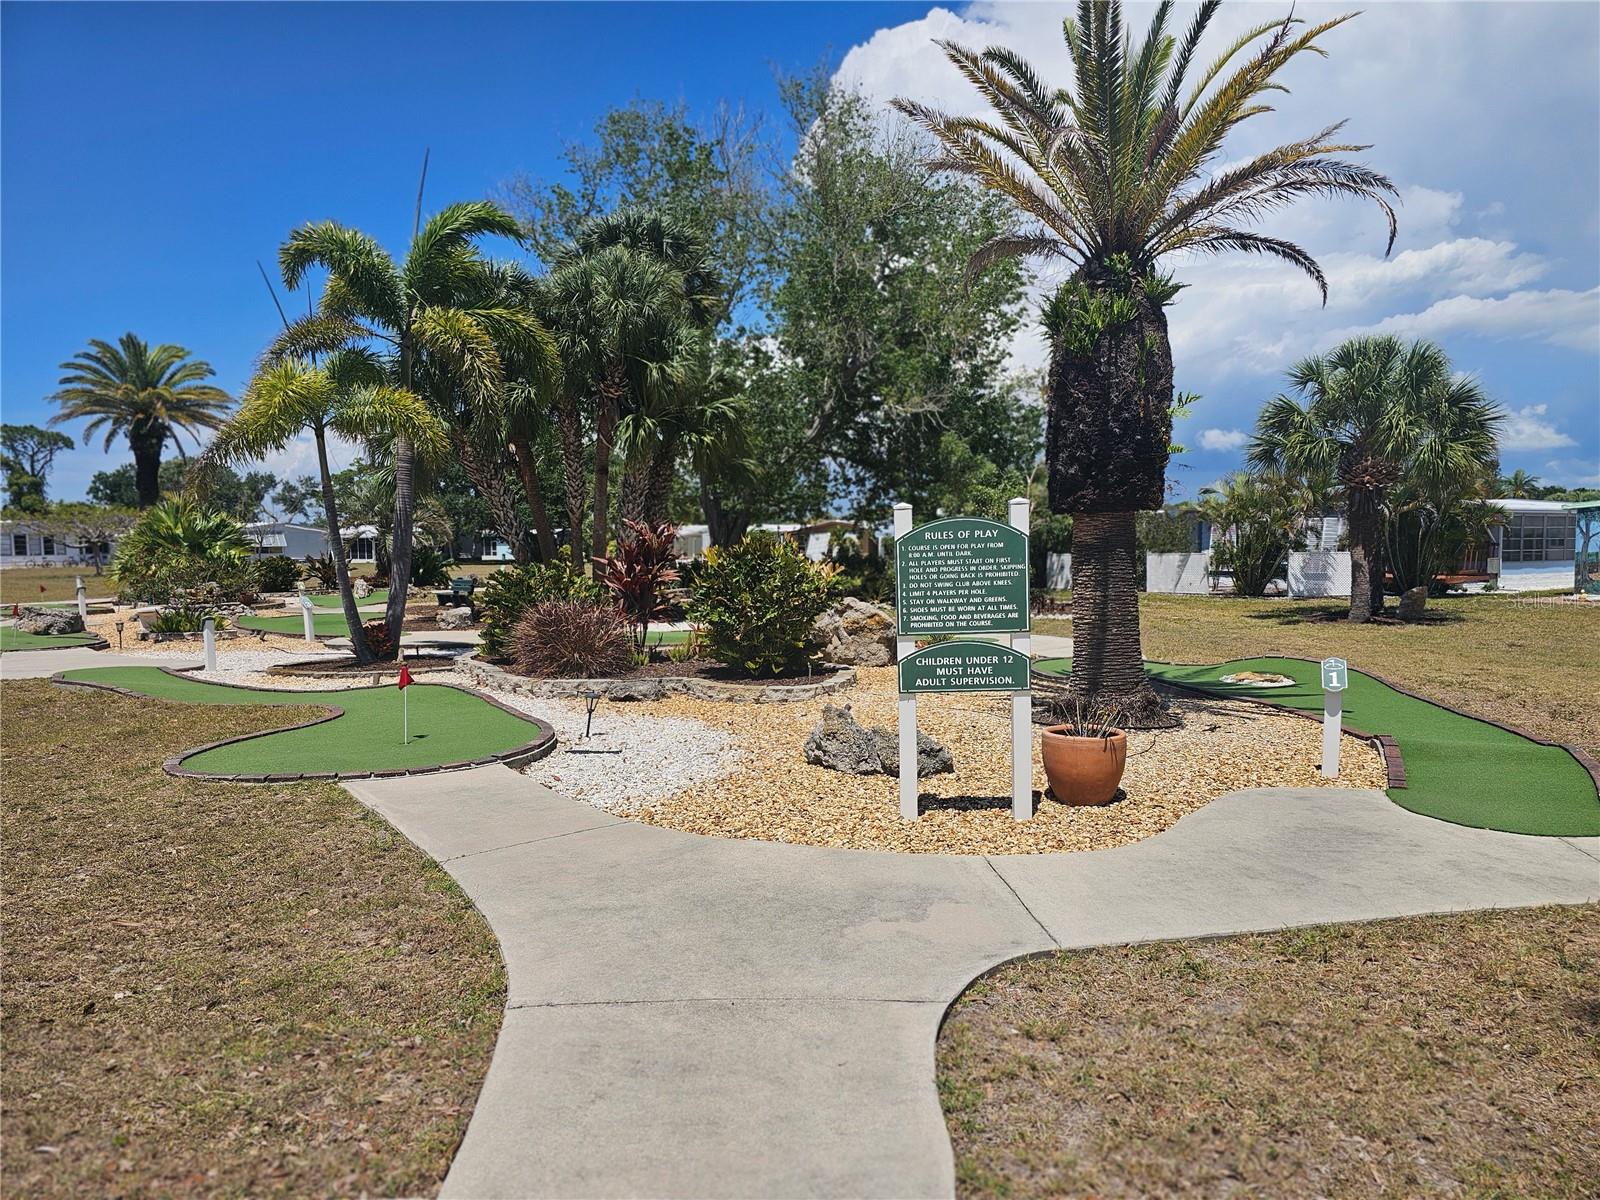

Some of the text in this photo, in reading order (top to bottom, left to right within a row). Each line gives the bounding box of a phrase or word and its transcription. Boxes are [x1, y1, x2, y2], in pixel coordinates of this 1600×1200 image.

[925, 530, 998, 540] RULES OF PLAY
[916, 657, 962, 665] CHILDREN
[966, 656, 998, 664] UNDER
[937, 667, 963, 675] MUST
[915, 676, 1015, 686] ADULT SUPERVISION.
[1329, 672, 1341, 686] 1
